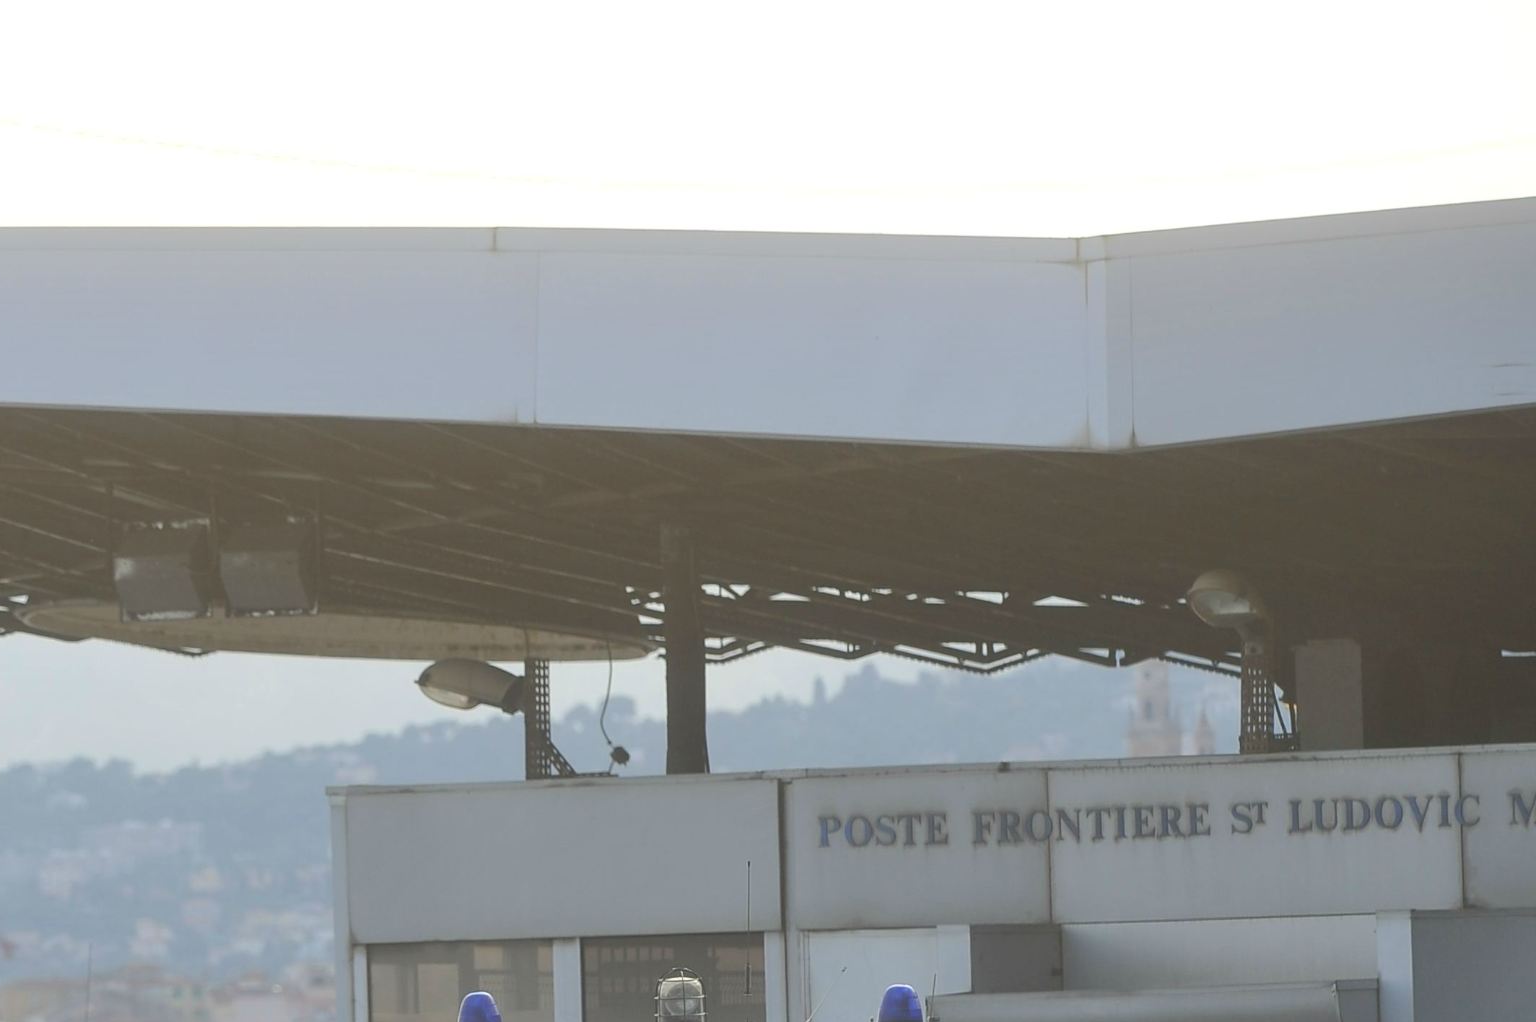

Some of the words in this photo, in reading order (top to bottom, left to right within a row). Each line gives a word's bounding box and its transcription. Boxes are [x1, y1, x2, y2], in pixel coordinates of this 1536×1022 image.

[817, 810, 950, 848] POSTE
[971, 803, 1212, 846] FRONTIERE
[1288, 793, 1481, 835] LUDOVIC
